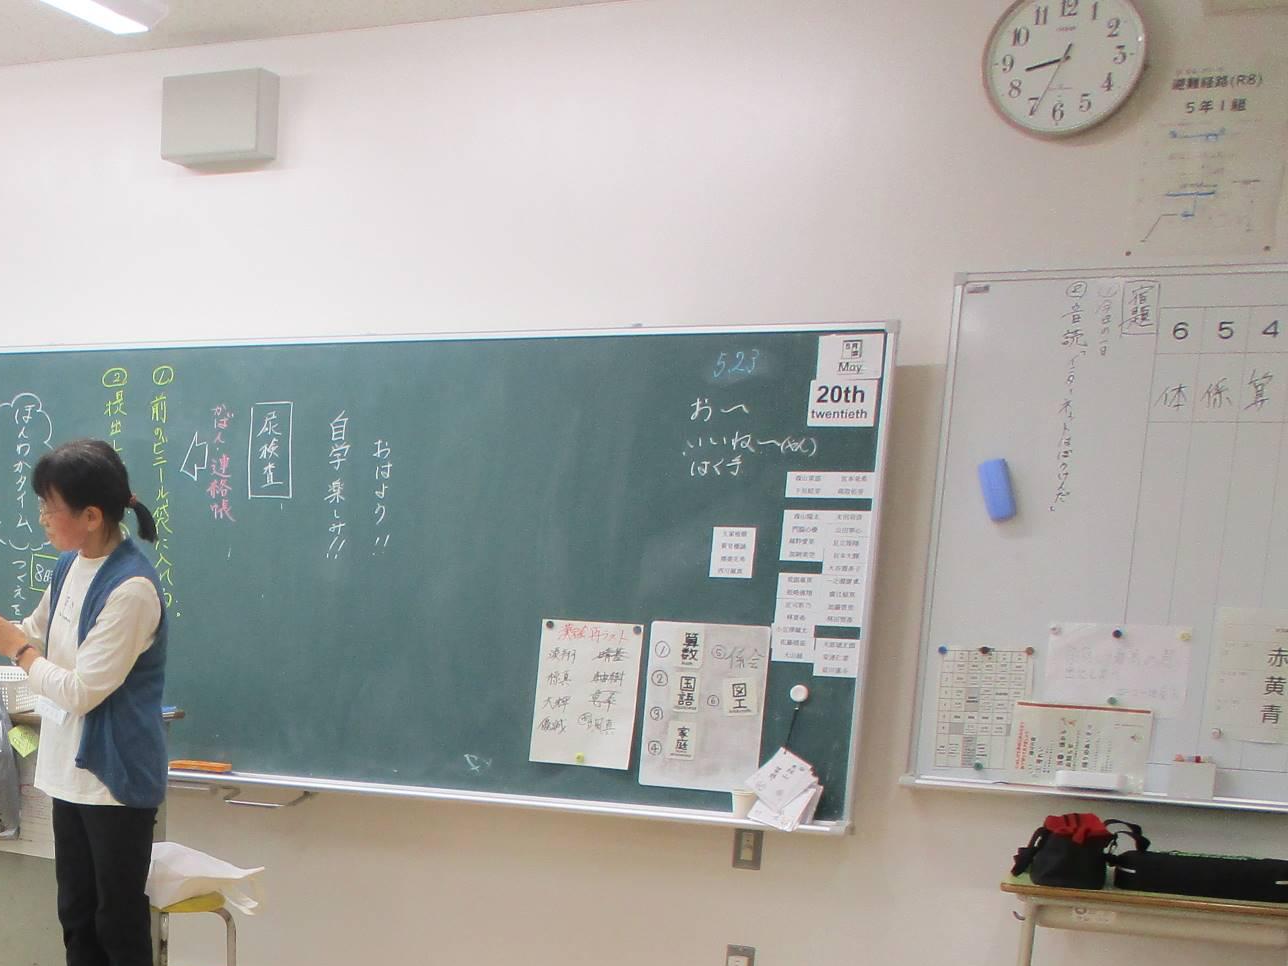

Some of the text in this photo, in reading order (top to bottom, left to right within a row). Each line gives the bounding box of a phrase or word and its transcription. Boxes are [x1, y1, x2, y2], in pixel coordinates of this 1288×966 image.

[1034, 6, 1048, 25] 11
[1061, 0, 1078, 17] 12
[1091, 2, 1098, 20] 1
[1012, 27, 1029, 47] 10
[1107, 18, 1121, 37] 2
[1002, 54, 1014, 72] 9
[1113, 45, 1126, 64] 3
[1008, 79, 1022, 98] 8
[1101, 72, 1113, 91] 4
[1028, 97, 1039, 116] 7
[1052, 102, 1064, 121] 6
[1079, 93, 1092, 112] 5
[1172, 322, 1189, 340] 6
[1218, 321, 1234, 340] 5
[1262, 320, 1280, 337] 4
[838, 361, 862, 375] May
[816, 385, 865, 404] 20th
[811, 408, 868, 420] twentieth
[256, 410, 283, 488] 尿検査
[13, 404, 33, 533] ほんわかタイム
[681, 632, 699, 661] 算数
[677, 675, 697, 706] 国語
[732, 683, 747, 709] 図工
[676, 726, 690, 751] 家庭
